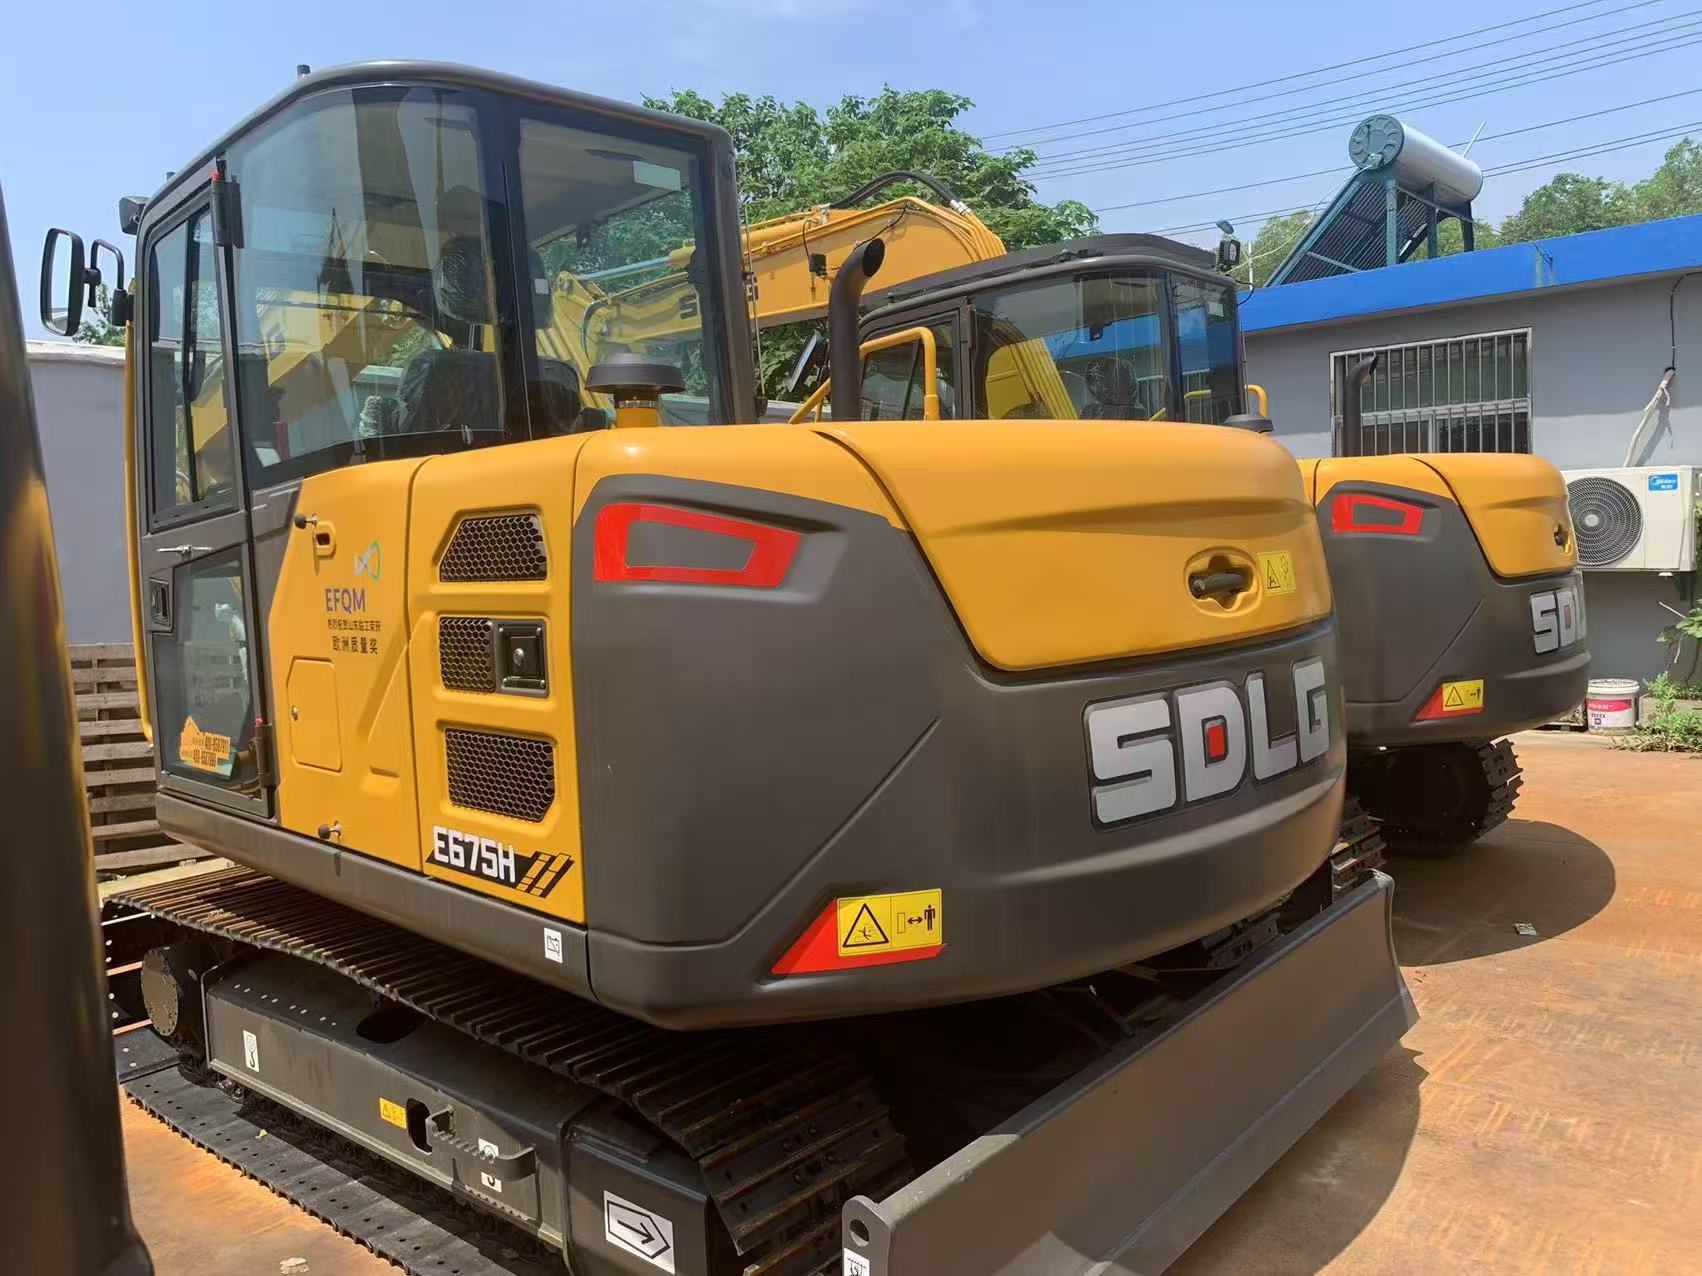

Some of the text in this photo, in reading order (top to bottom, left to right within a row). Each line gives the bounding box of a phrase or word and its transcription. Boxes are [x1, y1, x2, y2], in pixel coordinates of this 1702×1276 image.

[325, 588, 367, 613] EFQM
[332, 635, 378, 655] 欧洲质量奖
[1086, 658, 1330, 824] SDLG
[433, 824, 516, 883] E675H
